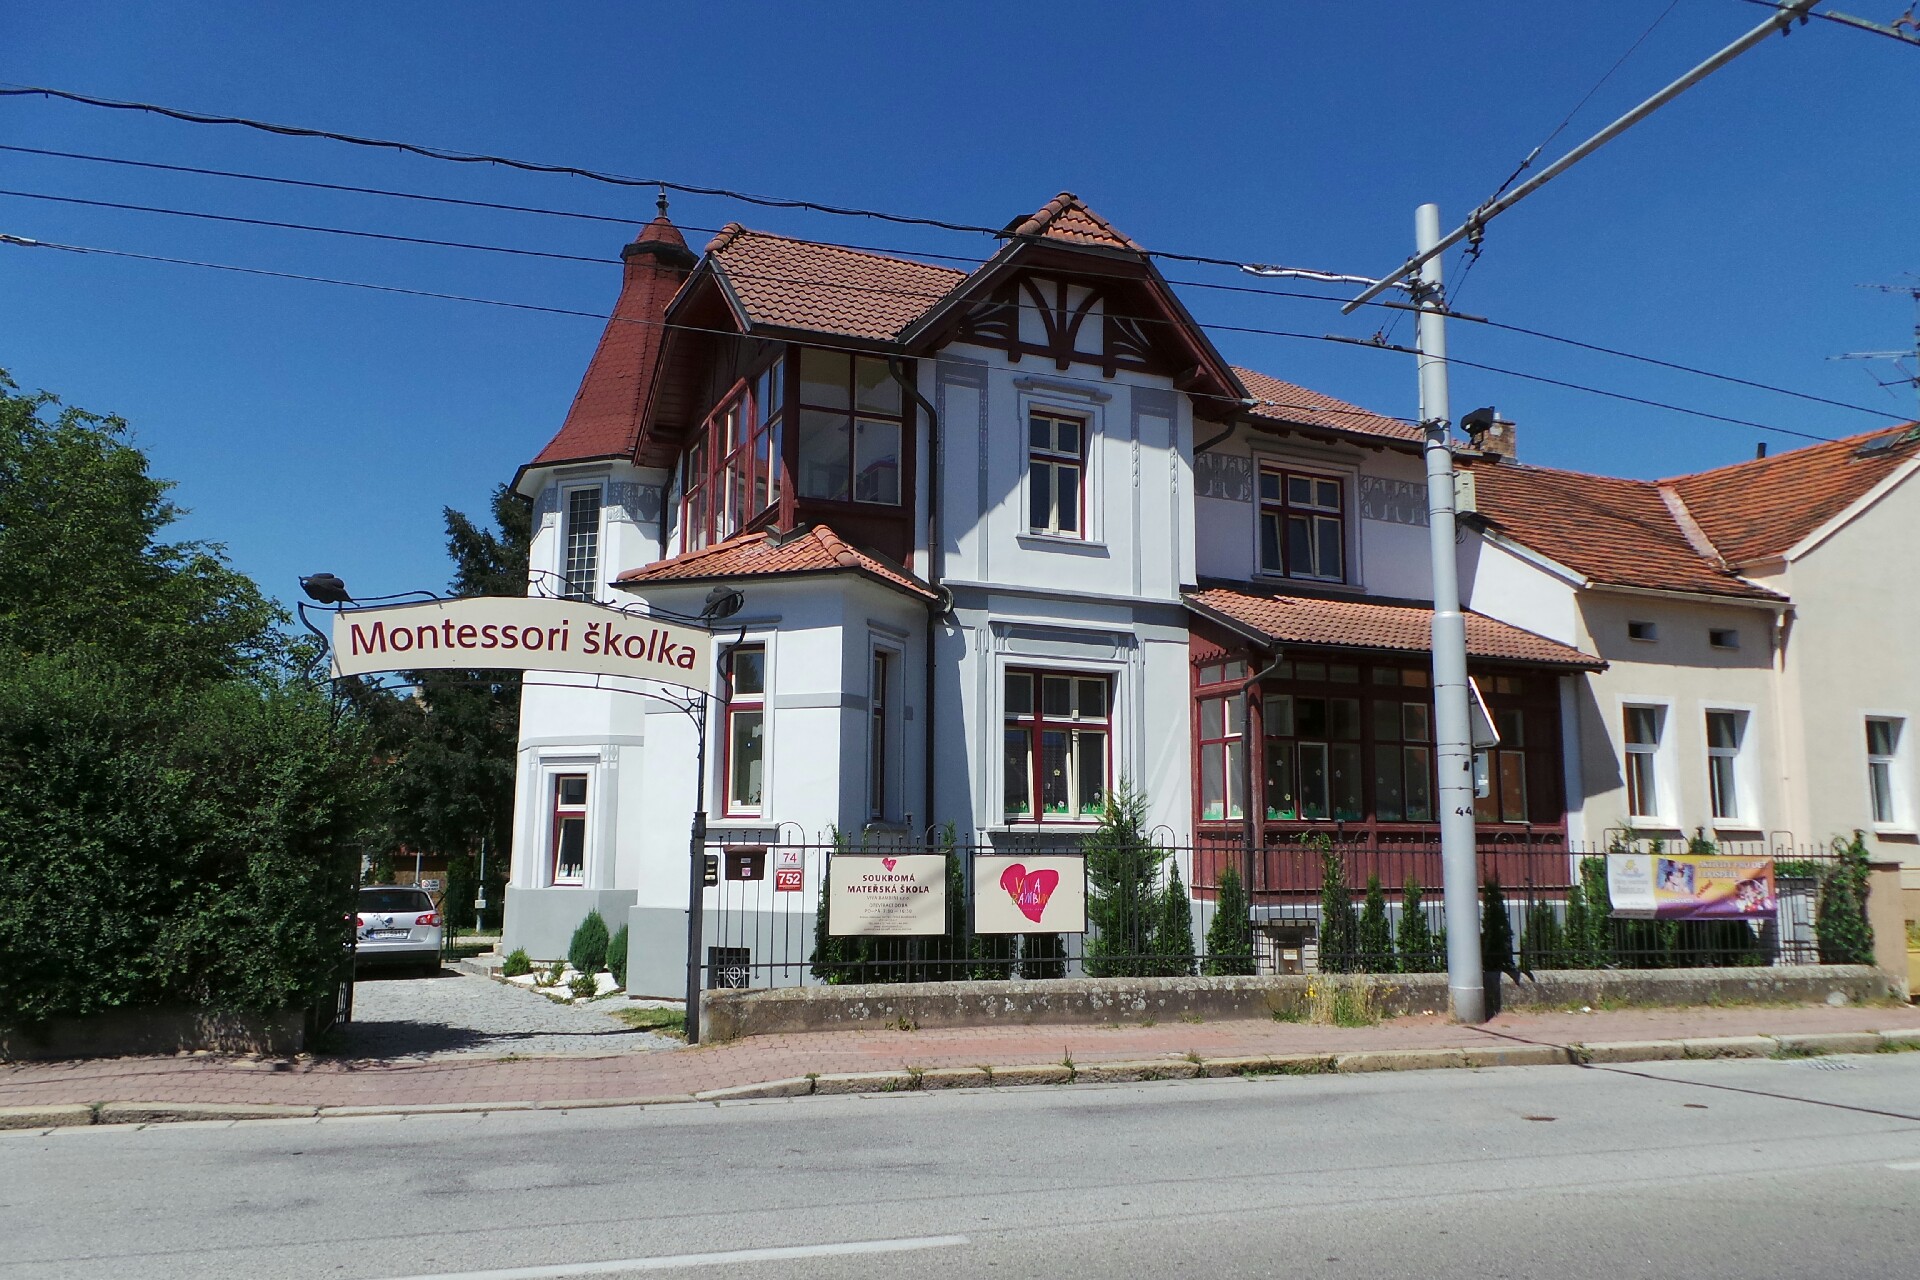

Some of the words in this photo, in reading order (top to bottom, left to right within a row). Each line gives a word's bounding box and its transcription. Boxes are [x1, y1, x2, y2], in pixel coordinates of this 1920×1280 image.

[350, 618, 569, 656] Montessori
[583, 622, 697, 670] školka
[1455, 806, 1473, 816] 44
[783, 853, 797, 863] 74
[778, 873, 801, 885] 752
[862, 873, 915, 882] SOUKROMÁ
[847, 884, 897, 893] MATEŘSKÁ
[900, 884, 930, 893] ŠKOLA
